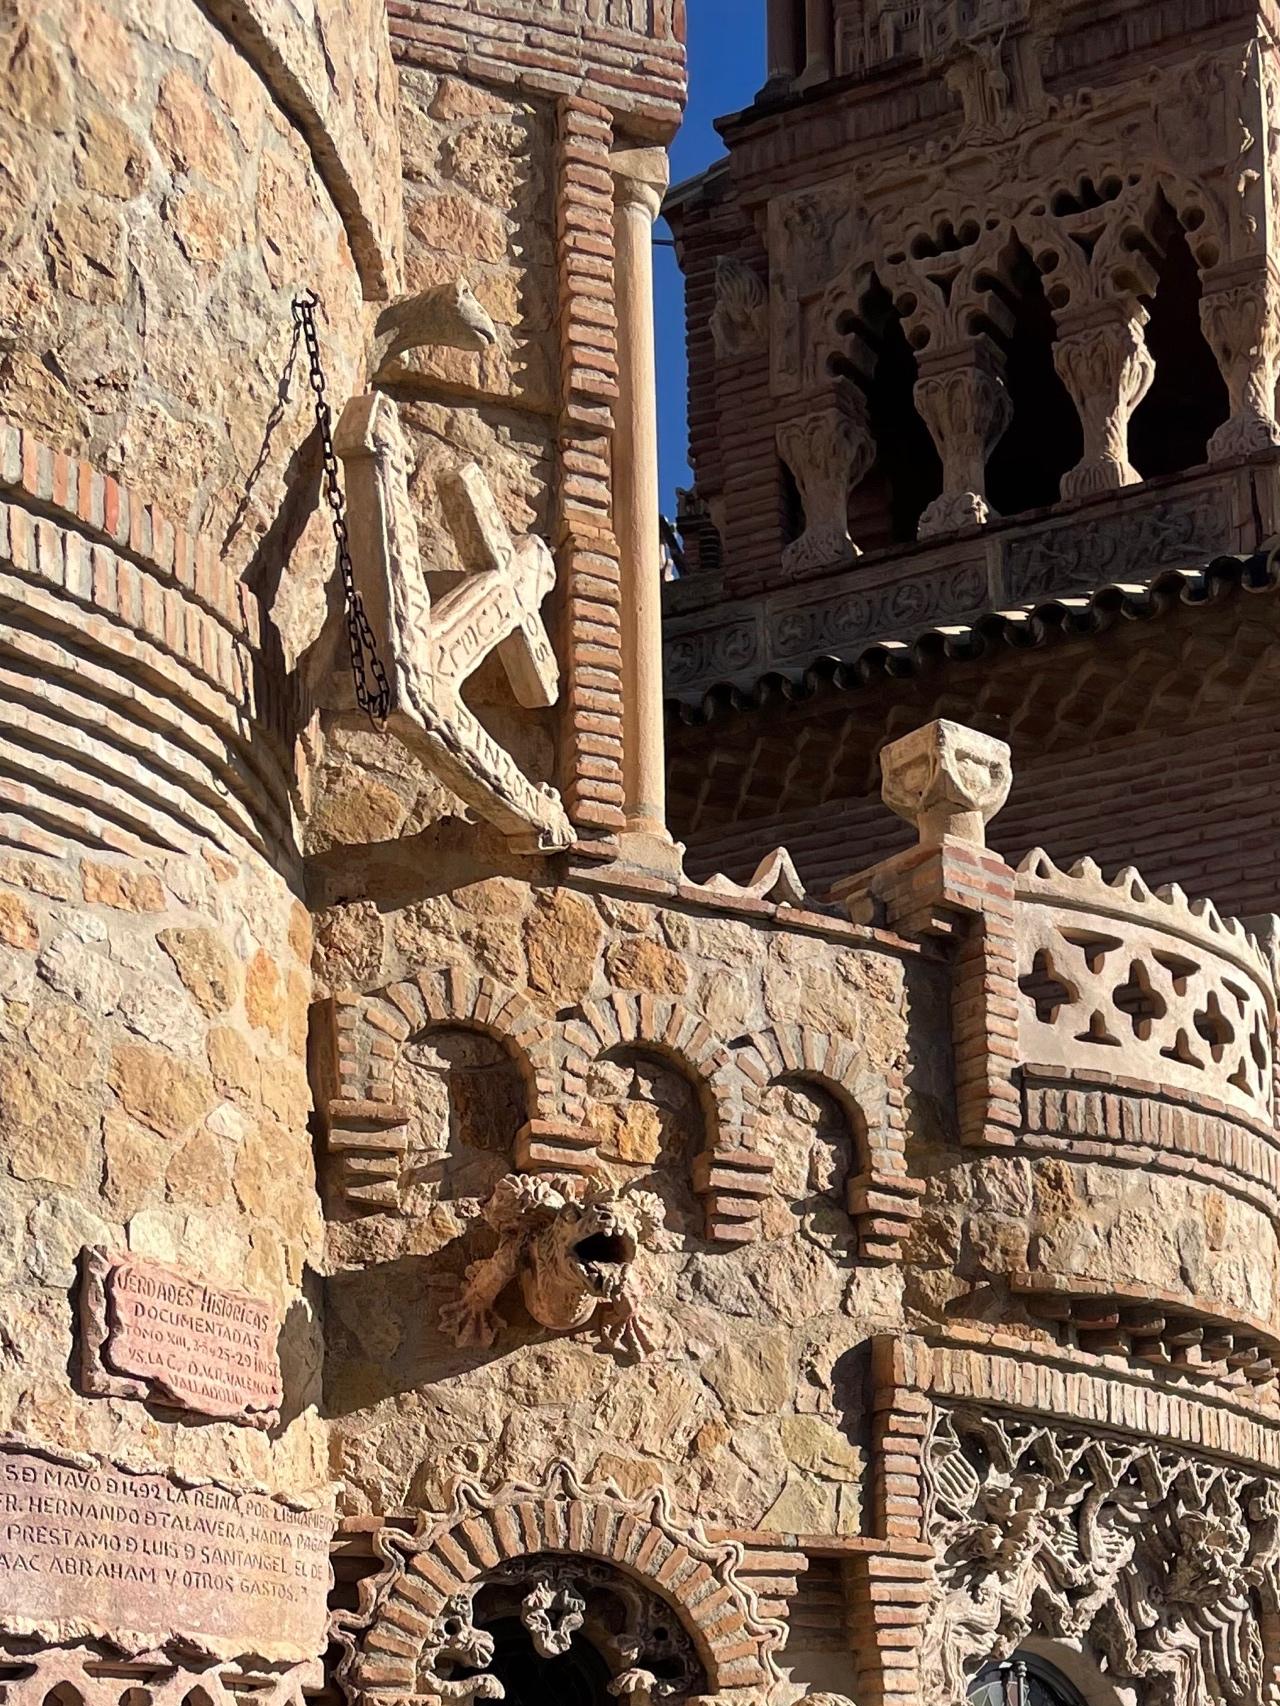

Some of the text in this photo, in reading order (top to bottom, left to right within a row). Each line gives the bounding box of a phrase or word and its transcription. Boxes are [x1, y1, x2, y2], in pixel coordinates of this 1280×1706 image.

[454, 702, 540, 817] PINZON
[117, 1268, 194, 1307] VERDADES
[125, 1323, 164, 1342] TOMO
[134, 1302, 261, 1350] DOCUMENTADAS
[29, 1496, 139, 1525] HERNANDO
[44, 1468, 101, 1491] MAYO
[122, 1481, 162, 1500] 1492
[167, 1487, 188, 1505] LA
[246, 1500, 270, 1518] POR
[7, 1524, 121, 1551] PRESTAMO
[143, 1538, 179, 1559] LUIS
[201, 1546, 288, 1574] SANTANGEL
[294, 1560, 307, 1578] EL
[311, 1564, 323, 1581] DE
[49, 1557, 157, 1584] ABRAHAM
[183, 1570, 234, 1593] OTROS
